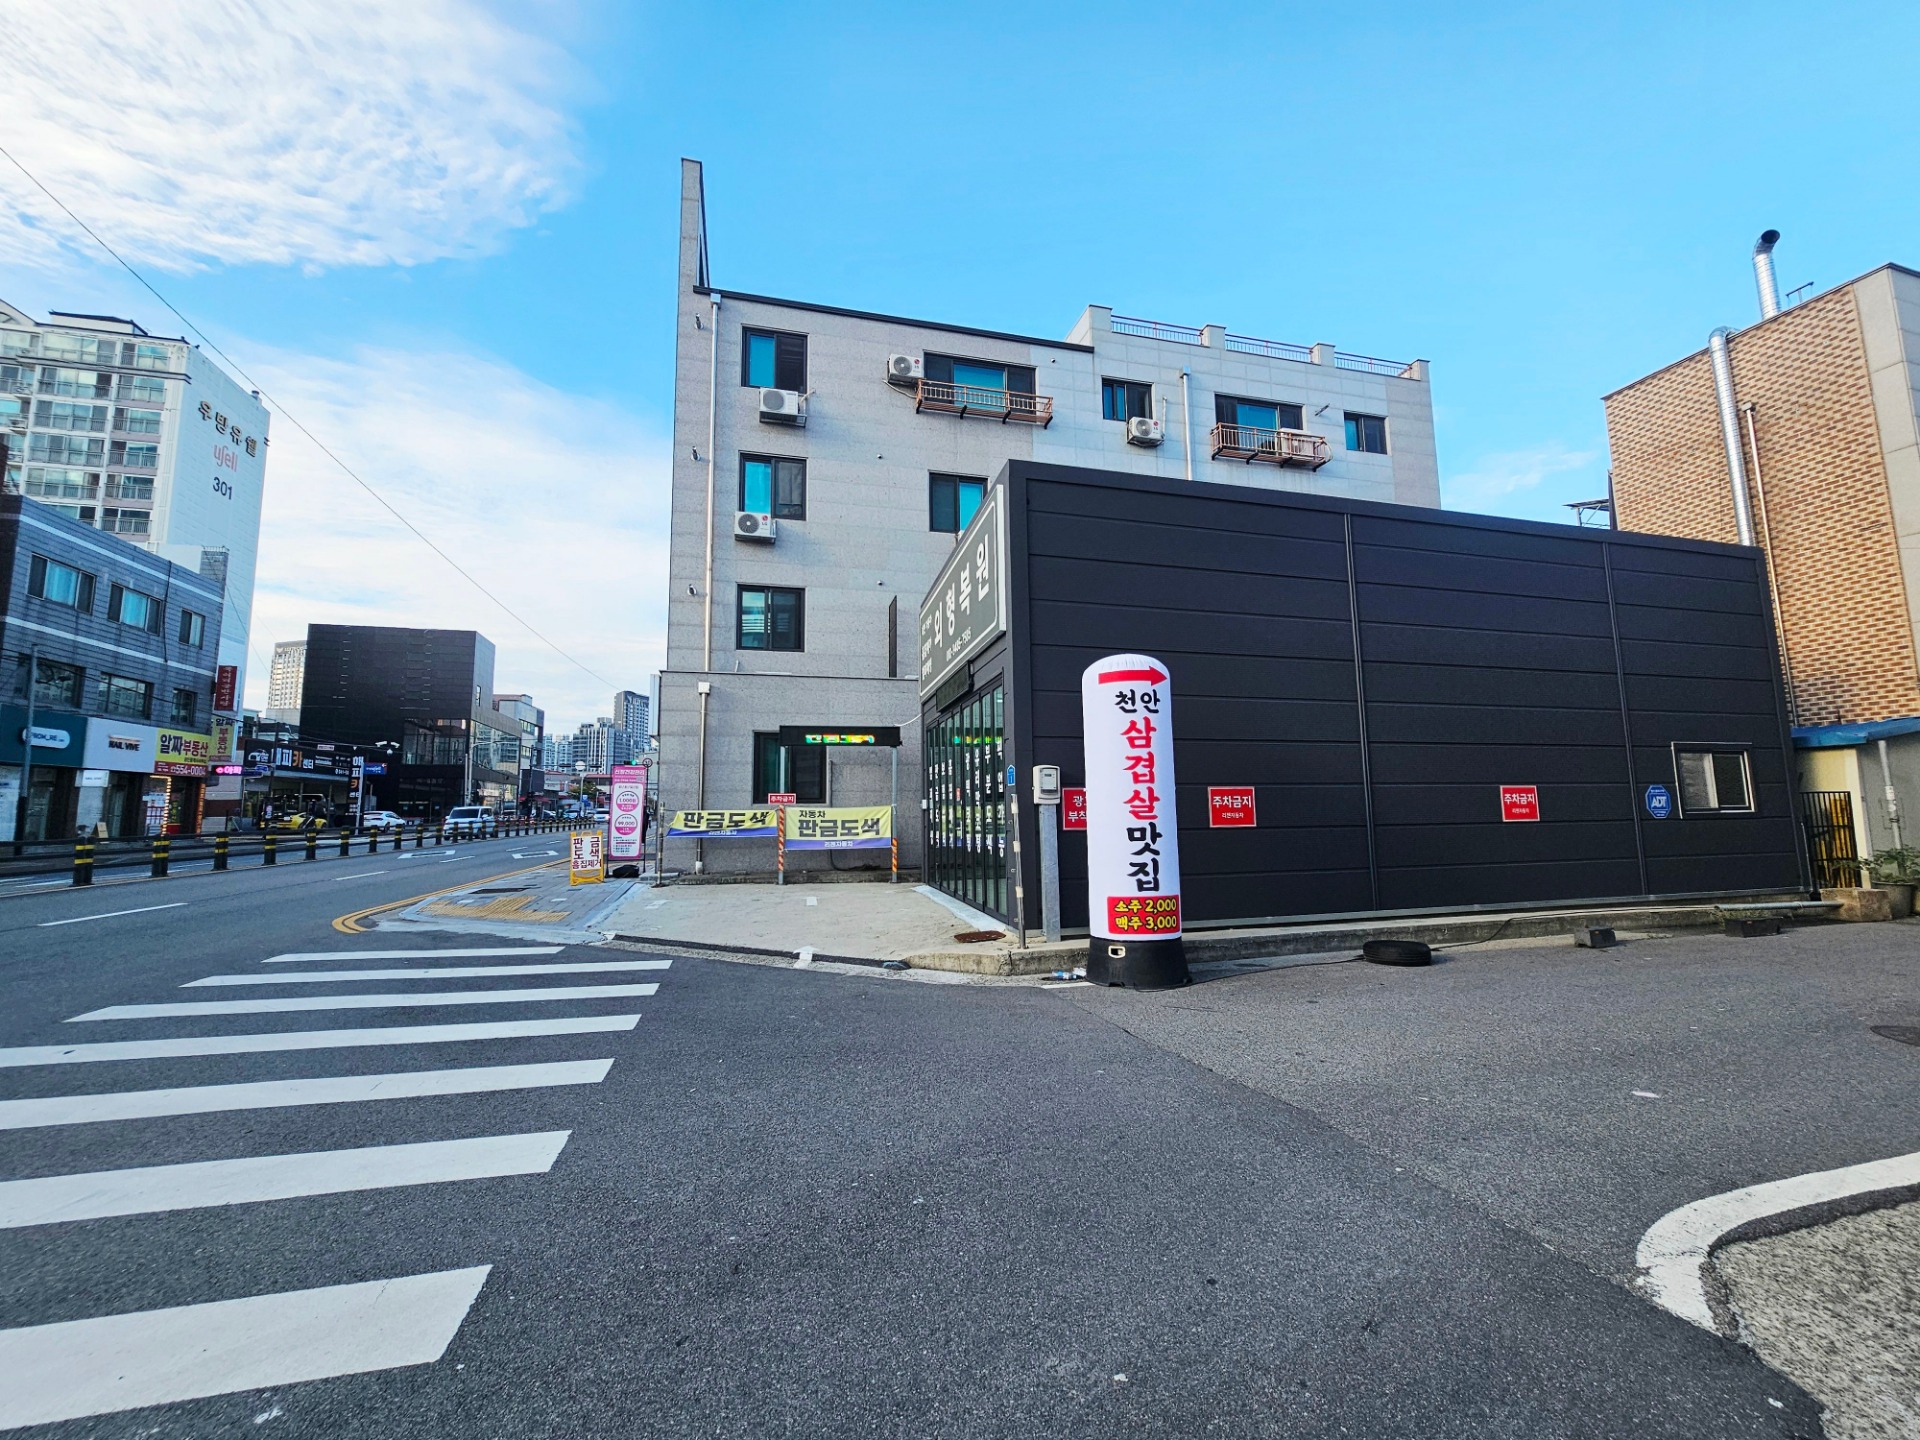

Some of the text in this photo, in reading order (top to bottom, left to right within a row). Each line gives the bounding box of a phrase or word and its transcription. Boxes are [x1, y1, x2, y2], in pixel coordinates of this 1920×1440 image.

[198, 401, 257, 457] 우방유쉘
[213, 477, 232, 500] 301
[933, 533, 990, 649] 외형복원
[1114, 689, 1161, 714] 천안
[1073, 795, 1087, 808] 광
[1213, 795, 1252, 809] 주차금지
[1504, 793, 1535, 805] 주차금지
[1651, 795, 1667, 808] ADT
[683, 811, 770, 829] 판금도색
[799, 809, 826, 819] 자동차
[798, 818, 881, 838] 판금도색
[573, 837, 584, 850] 판
[590, 836, 600, 849] 금
[574, 848, 600, 860] 도 색
[1114, 898, 1177, 915] 소주 2,000
[1115, 915, 1177, 931] 맥주 3,000
